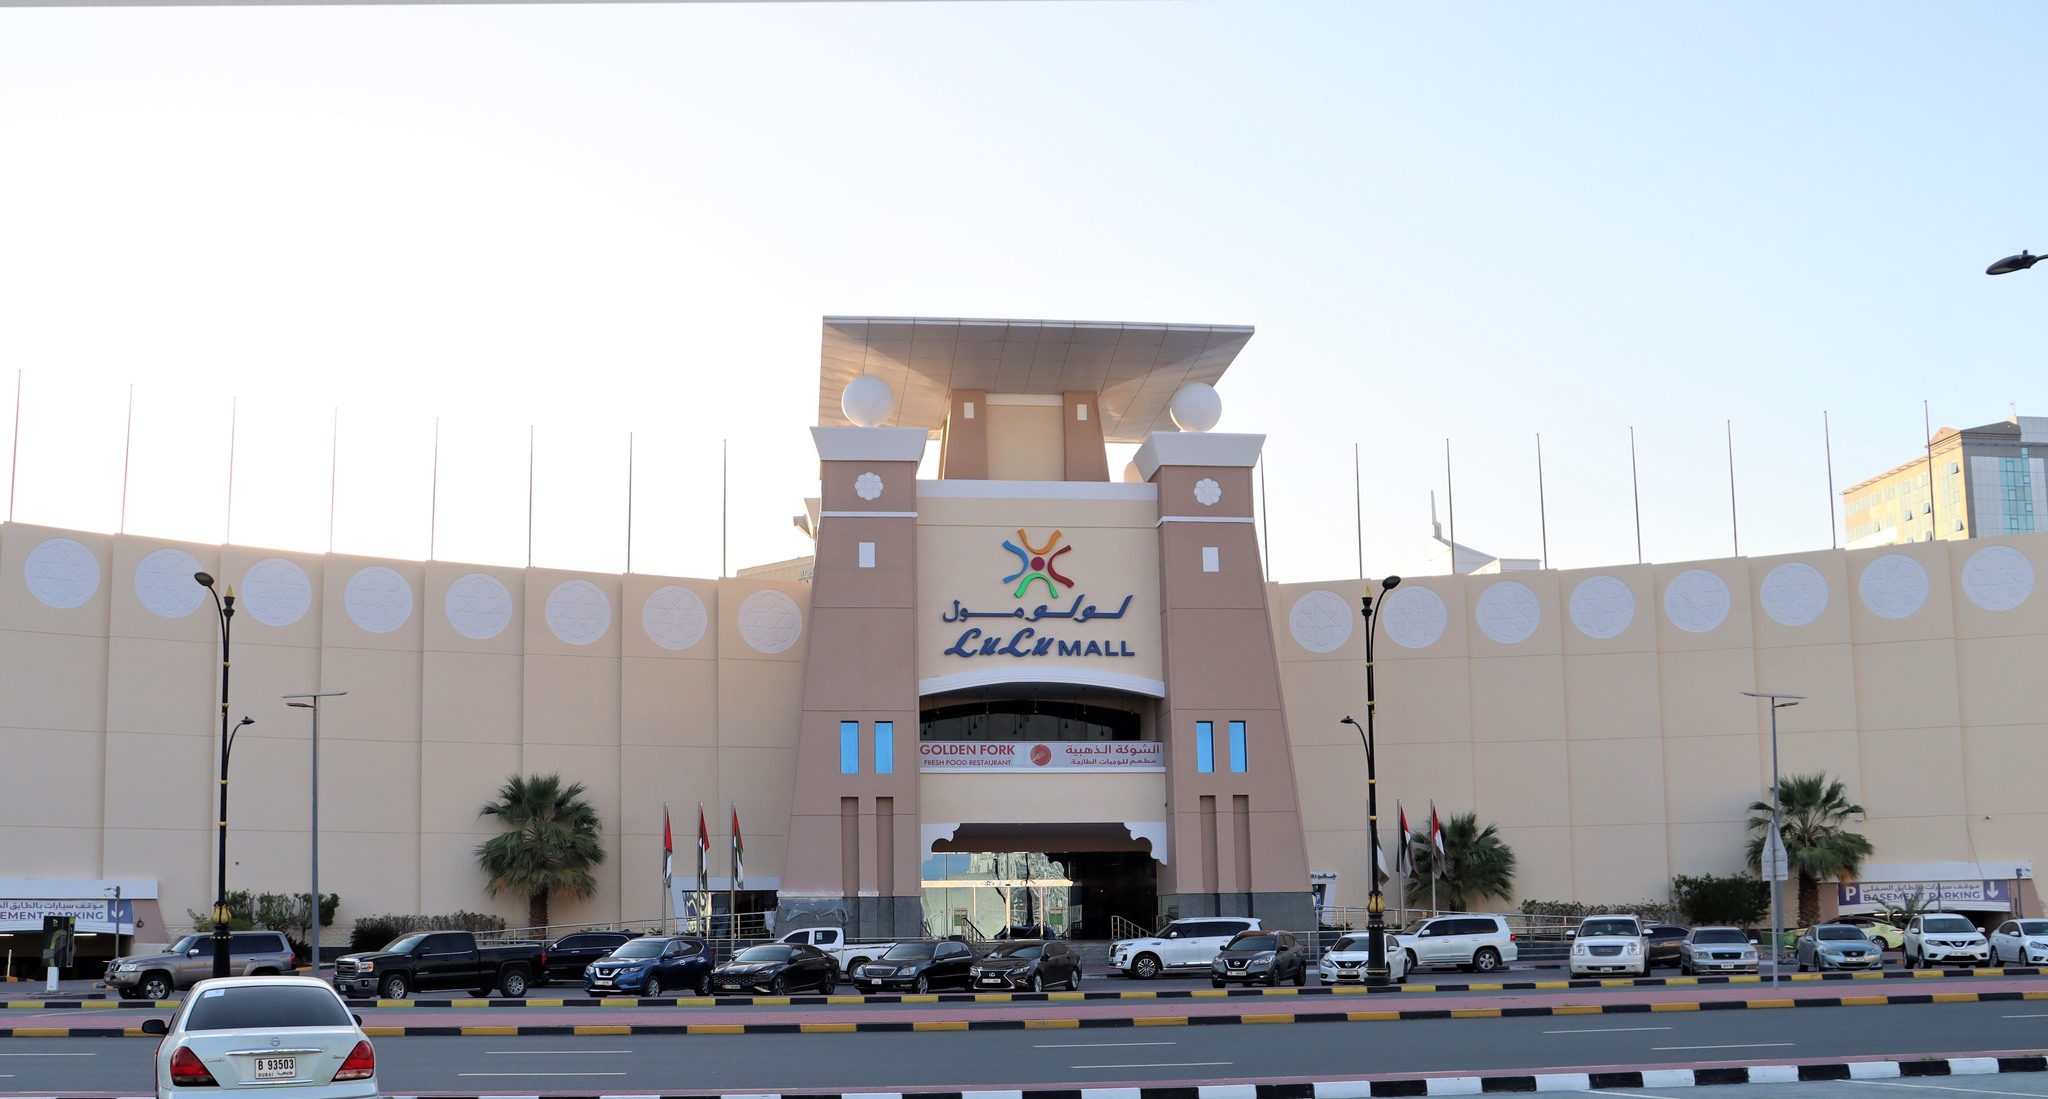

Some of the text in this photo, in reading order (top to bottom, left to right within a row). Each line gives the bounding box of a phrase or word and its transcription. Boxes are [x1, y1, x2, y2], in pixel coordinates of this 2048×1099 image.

[943, 594, 1133, 623] لولو مول
[1058, 640, 1136, 656] MALL
[920, 744, 1015, 755] GOLDEN FORK
[1065, 744, 1159, 756] الشوكة الذهبية
[1925, 883, 1952, 891] سيرات
[1845, 886, 1857, 901] P
[10, 901, 43, 911] بالطابق
[44, 901, 74, 910] سيارات
[75, 901, 104, 910] موقف
[258, 1059, 294, 1070] B 93503
